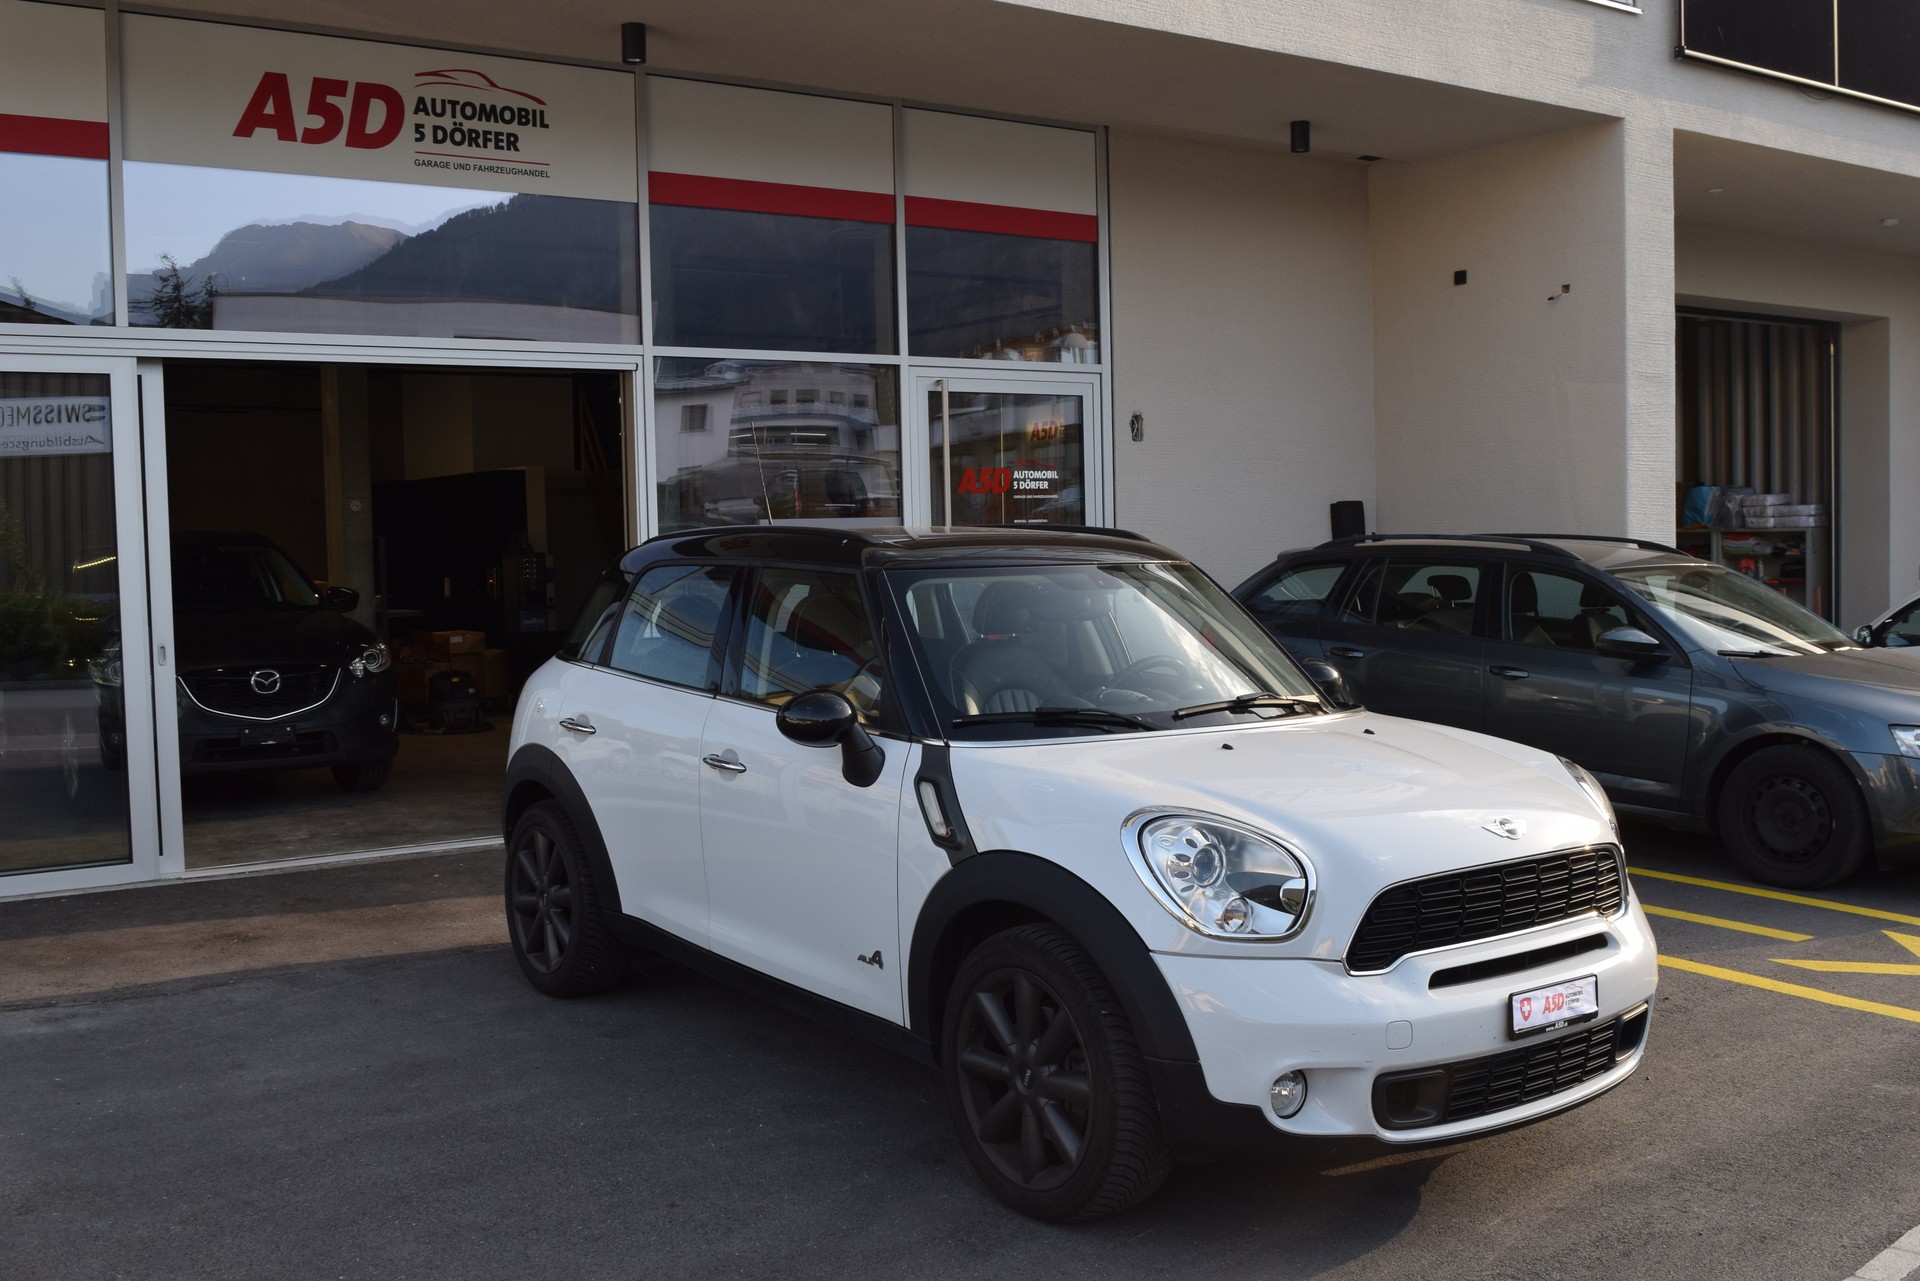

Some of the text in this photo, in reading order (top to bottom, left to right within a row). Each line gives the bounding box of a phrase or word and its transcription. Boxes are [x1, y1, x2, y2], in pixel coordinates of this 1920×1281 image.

[232, 71, 405, 150] A5D
[413, 96, 549, 129] AUTOMOBIL
[414, 122, 520, 152] 5 DÖRFER
[414, 158, 551, 178] GARAGE UND FAHRZEUGHANDEL
[958, 467, 1013, 494] A5D
[1013, 470, 1059, 479] AUTOMOBIL
[1013, 479, 1049, 490] 5 DÖRFER
[1542, 993, 1564, 1014] A5D
